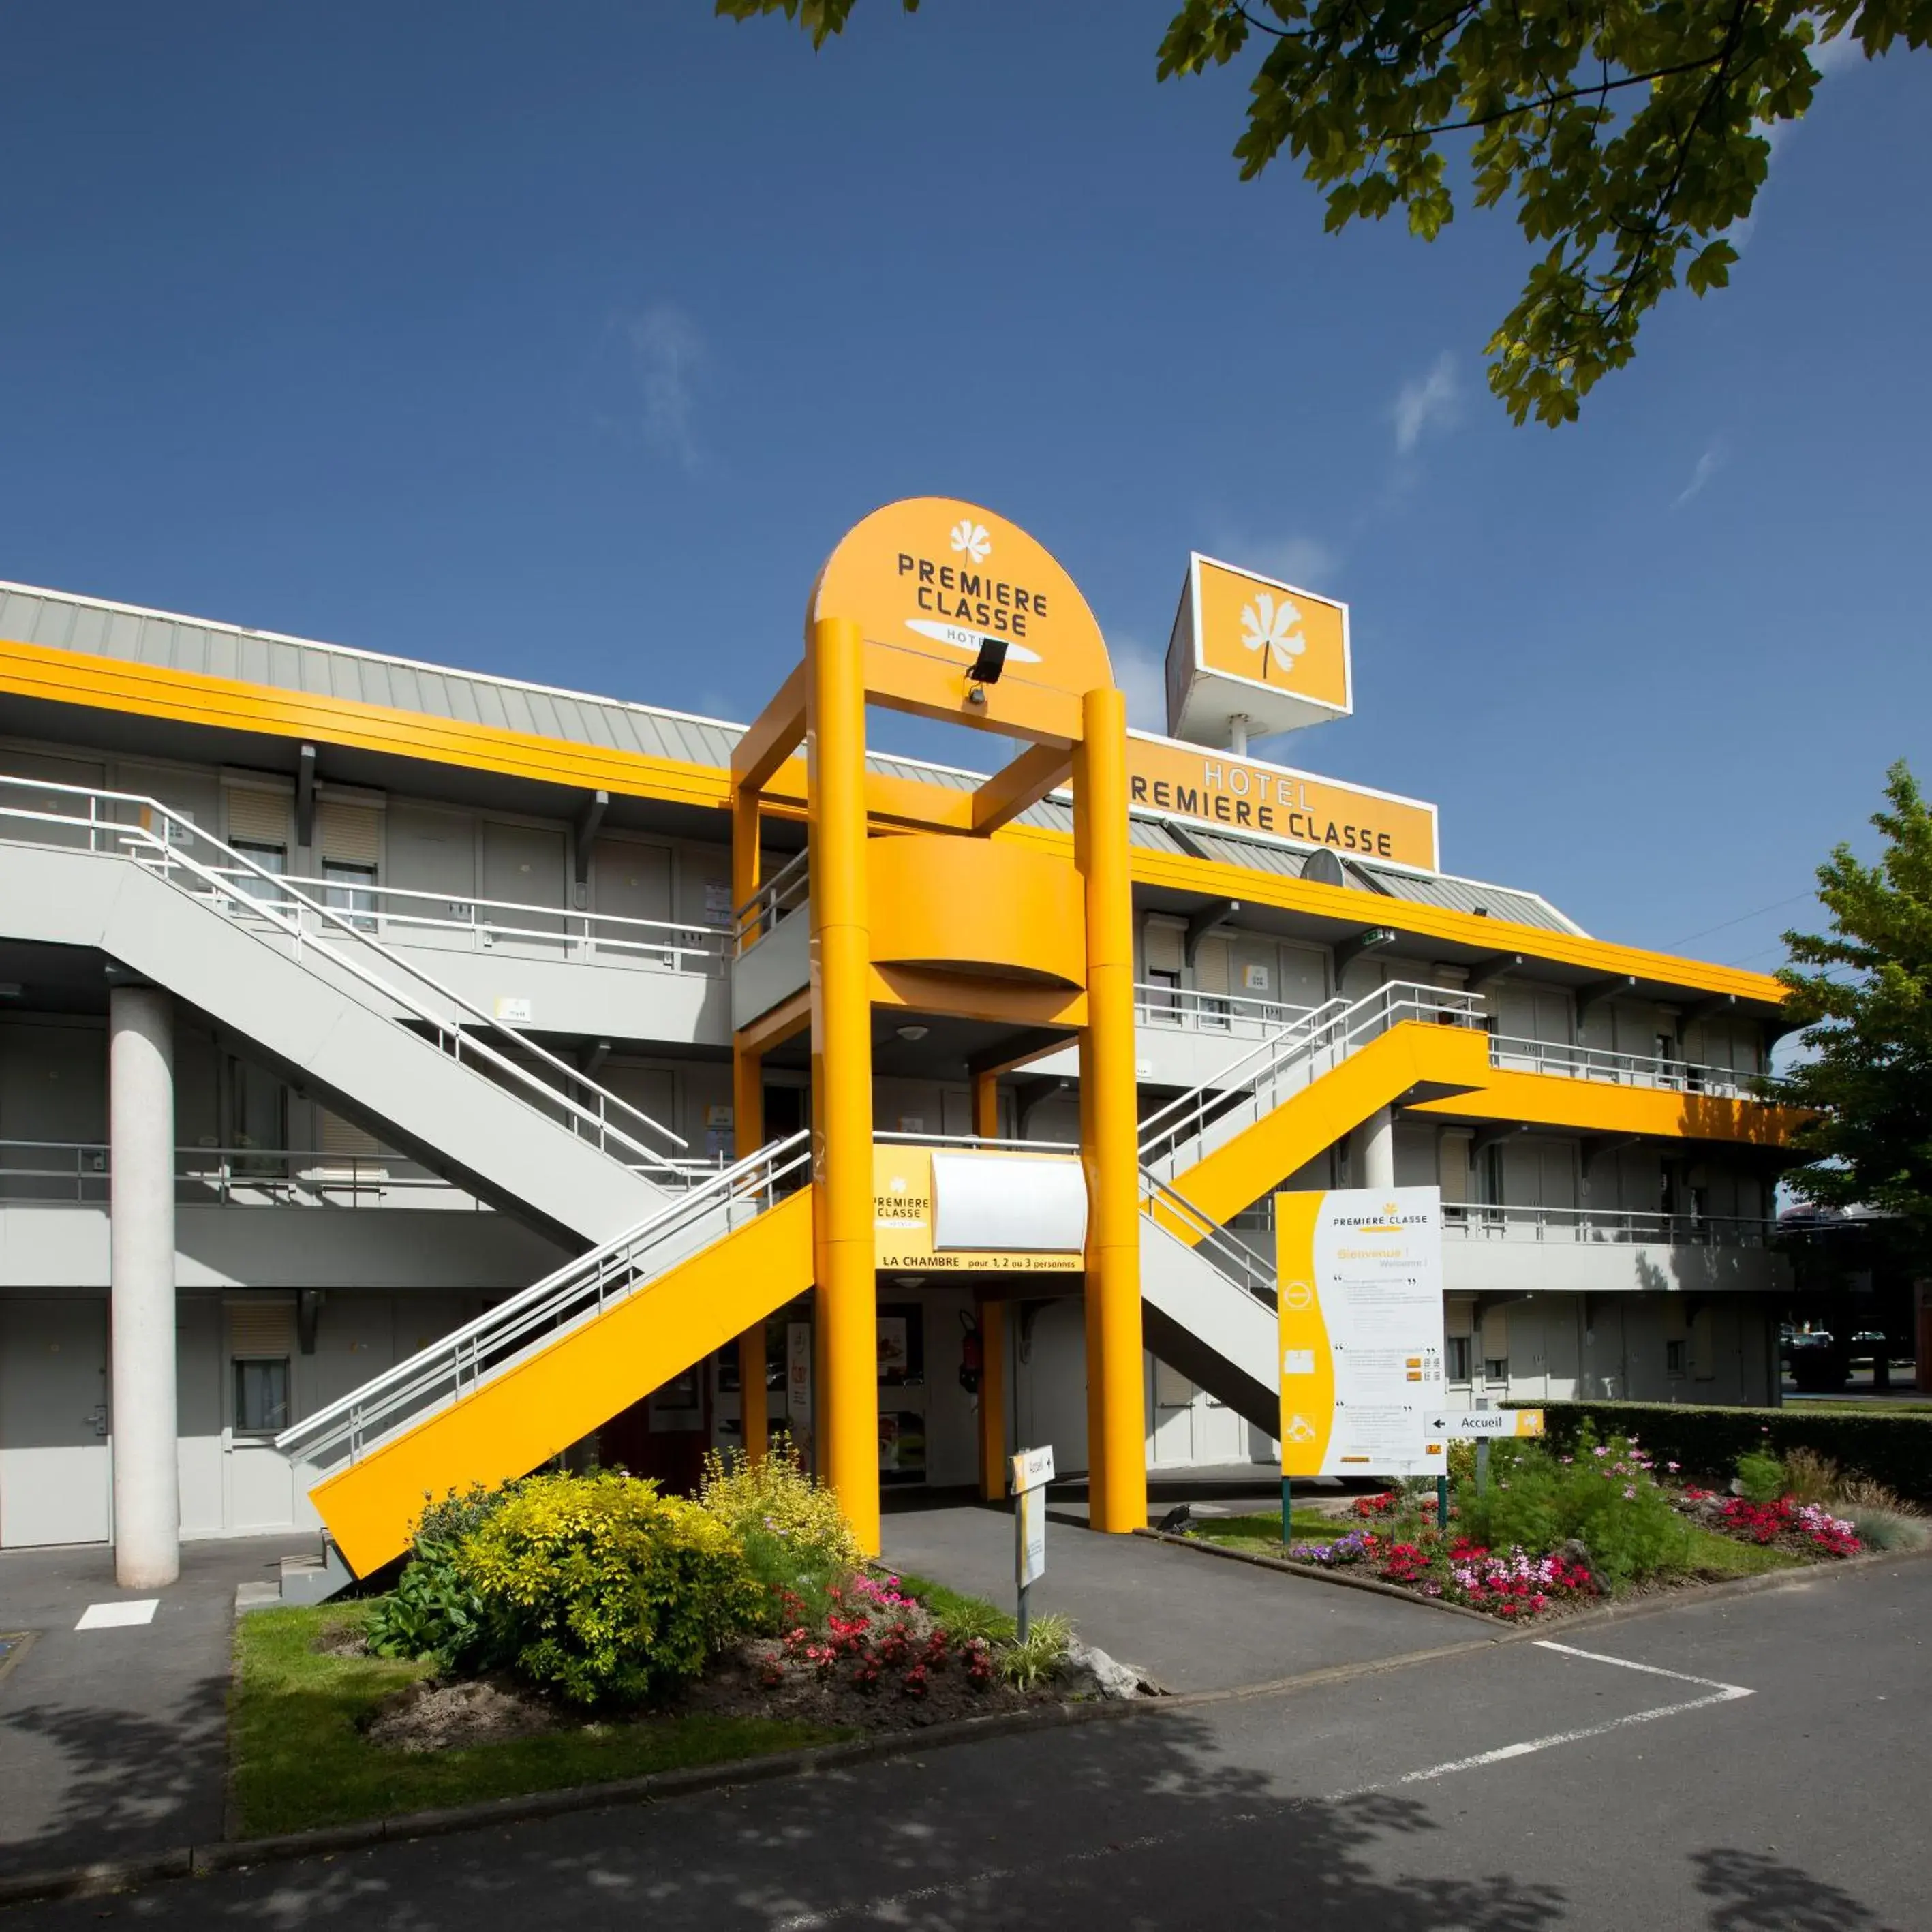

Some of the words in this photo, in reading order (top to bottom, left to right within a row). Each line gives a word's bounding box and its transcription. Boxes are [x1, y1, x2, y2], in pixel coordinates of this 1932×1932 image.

[898, 553, 1048, 617] PREMIERE
[917, 586, 1028, 638] CLASSE
[947, 628, 985, 647] HOTE
[1203, 760, 1315, 812] HOTEL
[1131, 776, 1274, 831] REMIERE
[1289, 813, 1392, 858] CLASSE
[878, 1208, 921, 1218] CLASSE
[1333, 1216, 1385, 1226] PREMIERE
[1389, 1215, 1428, 1225] CLASSE
[883, 1256, 899, 1266] LA
[902, 1256, 960, 1267] CHAMBRE
[968, 1259, 987, 1268] pour
[1002, 1258, 1009, 1268] 2
[1025, 1258, 1031, 1268] 3
[1033, 1260, 1075, 1269] personnes
[1461, 1416, 1502, 1428] Accueil
